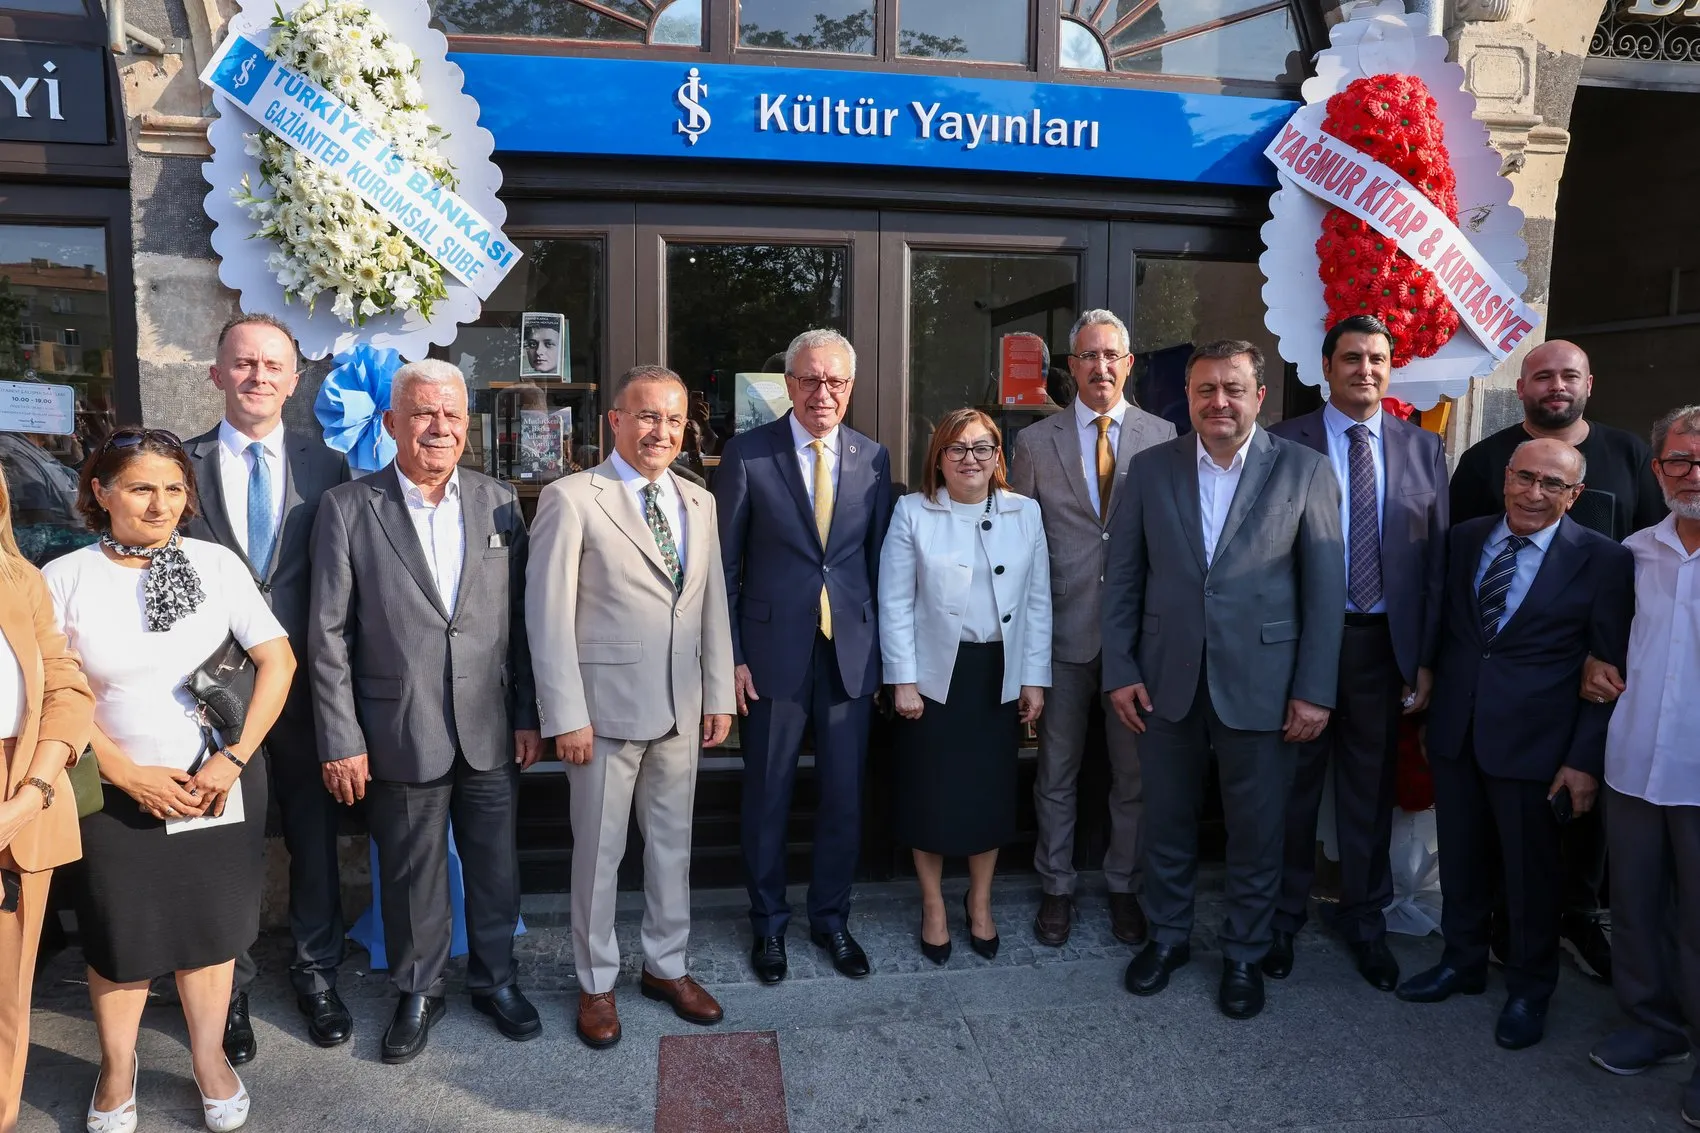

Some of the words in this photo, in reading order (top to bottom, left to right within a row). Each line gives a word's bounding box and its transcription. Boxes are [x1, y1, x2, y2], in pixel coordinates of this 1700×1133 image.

[264, 99, 350, 167] GAZİANTEP
[346, 160, 439, 246] KURUMSAL
[434, 235, 485, 281] ŞUBE
[273, 66, 376, 151] TÜRKİYE
[375, 143, 404, 177] İŞ
[405, 171, 514, 268] BANKASI
[760, 93, 899, 136] Kültür
[911, 101, 1099, 149] Yayınları
[1273, 123, 1368, 201] YAĞMUR
[1354, 175, 1428, 239] KİTAP
[1417, 227, 1444, 261] &
[1433, 243, 1533, 353] KIRTASİYE
